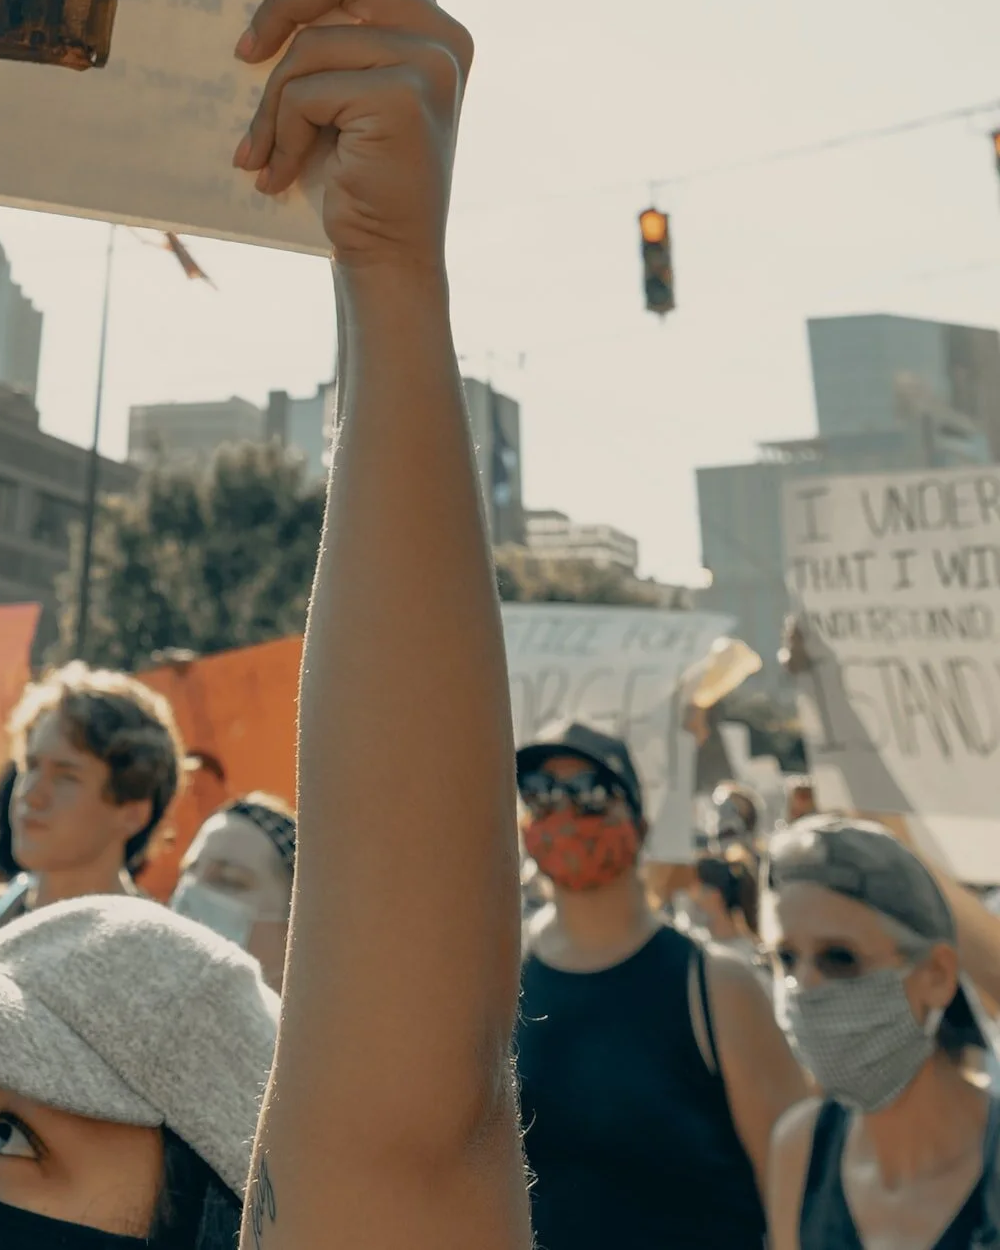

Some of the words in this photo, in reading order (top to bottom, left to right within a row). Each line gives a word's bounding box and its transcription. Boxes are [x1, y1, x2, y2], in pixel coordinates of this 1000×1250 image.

[797, 484, 832, 545] I
[790, 552, 877, 594] THAT
[890, 548, 919, 591] I
